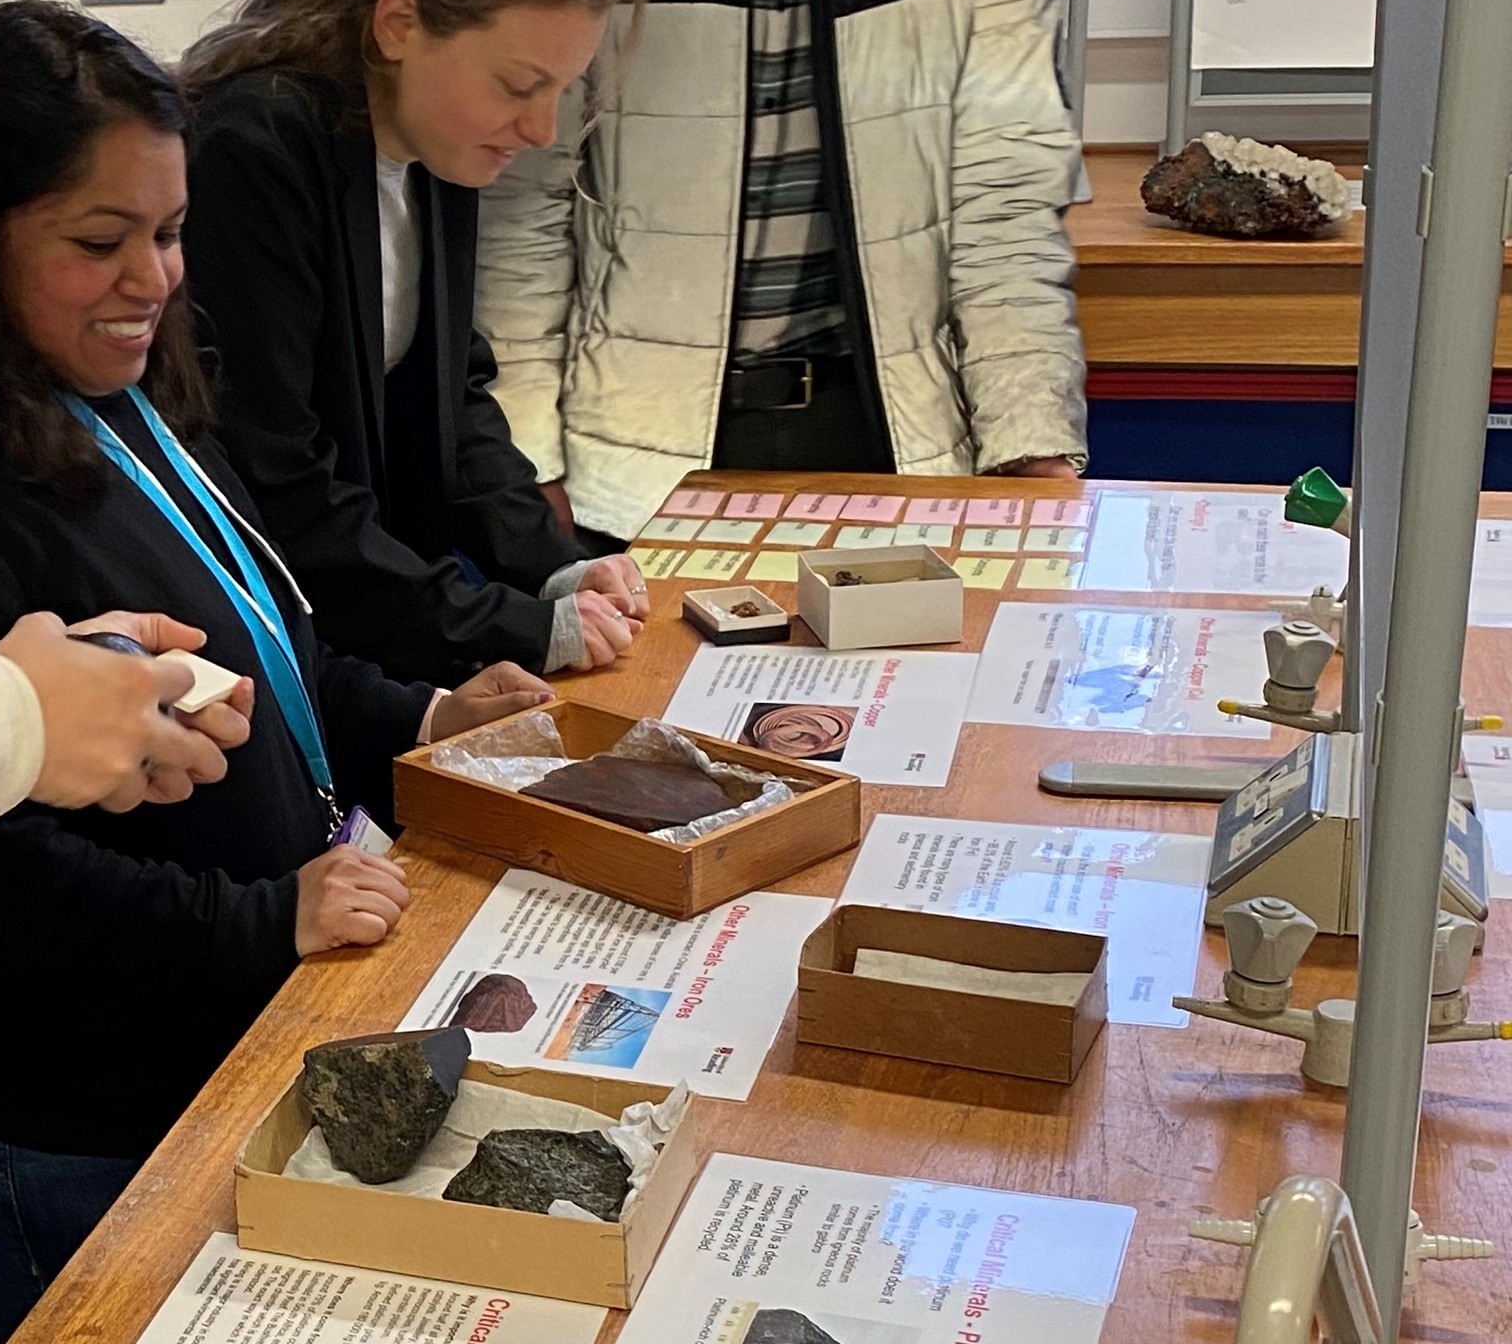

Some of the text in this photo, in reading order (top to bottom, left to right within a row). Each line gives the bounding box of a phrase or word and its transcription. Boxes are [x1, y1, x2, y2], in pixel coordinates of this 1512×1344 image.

[723, 904, 750, 928] Other
[1091, 909, 1112, 930] Iron
[702, 929, 737, 966] Minerals
[687, 976, 713, 995] Iron
[674, 996, 702, 1018] Ores
[980, 1212, 1020, 1259] Critical
[960, 1260, 1003, 1319] Minerals
